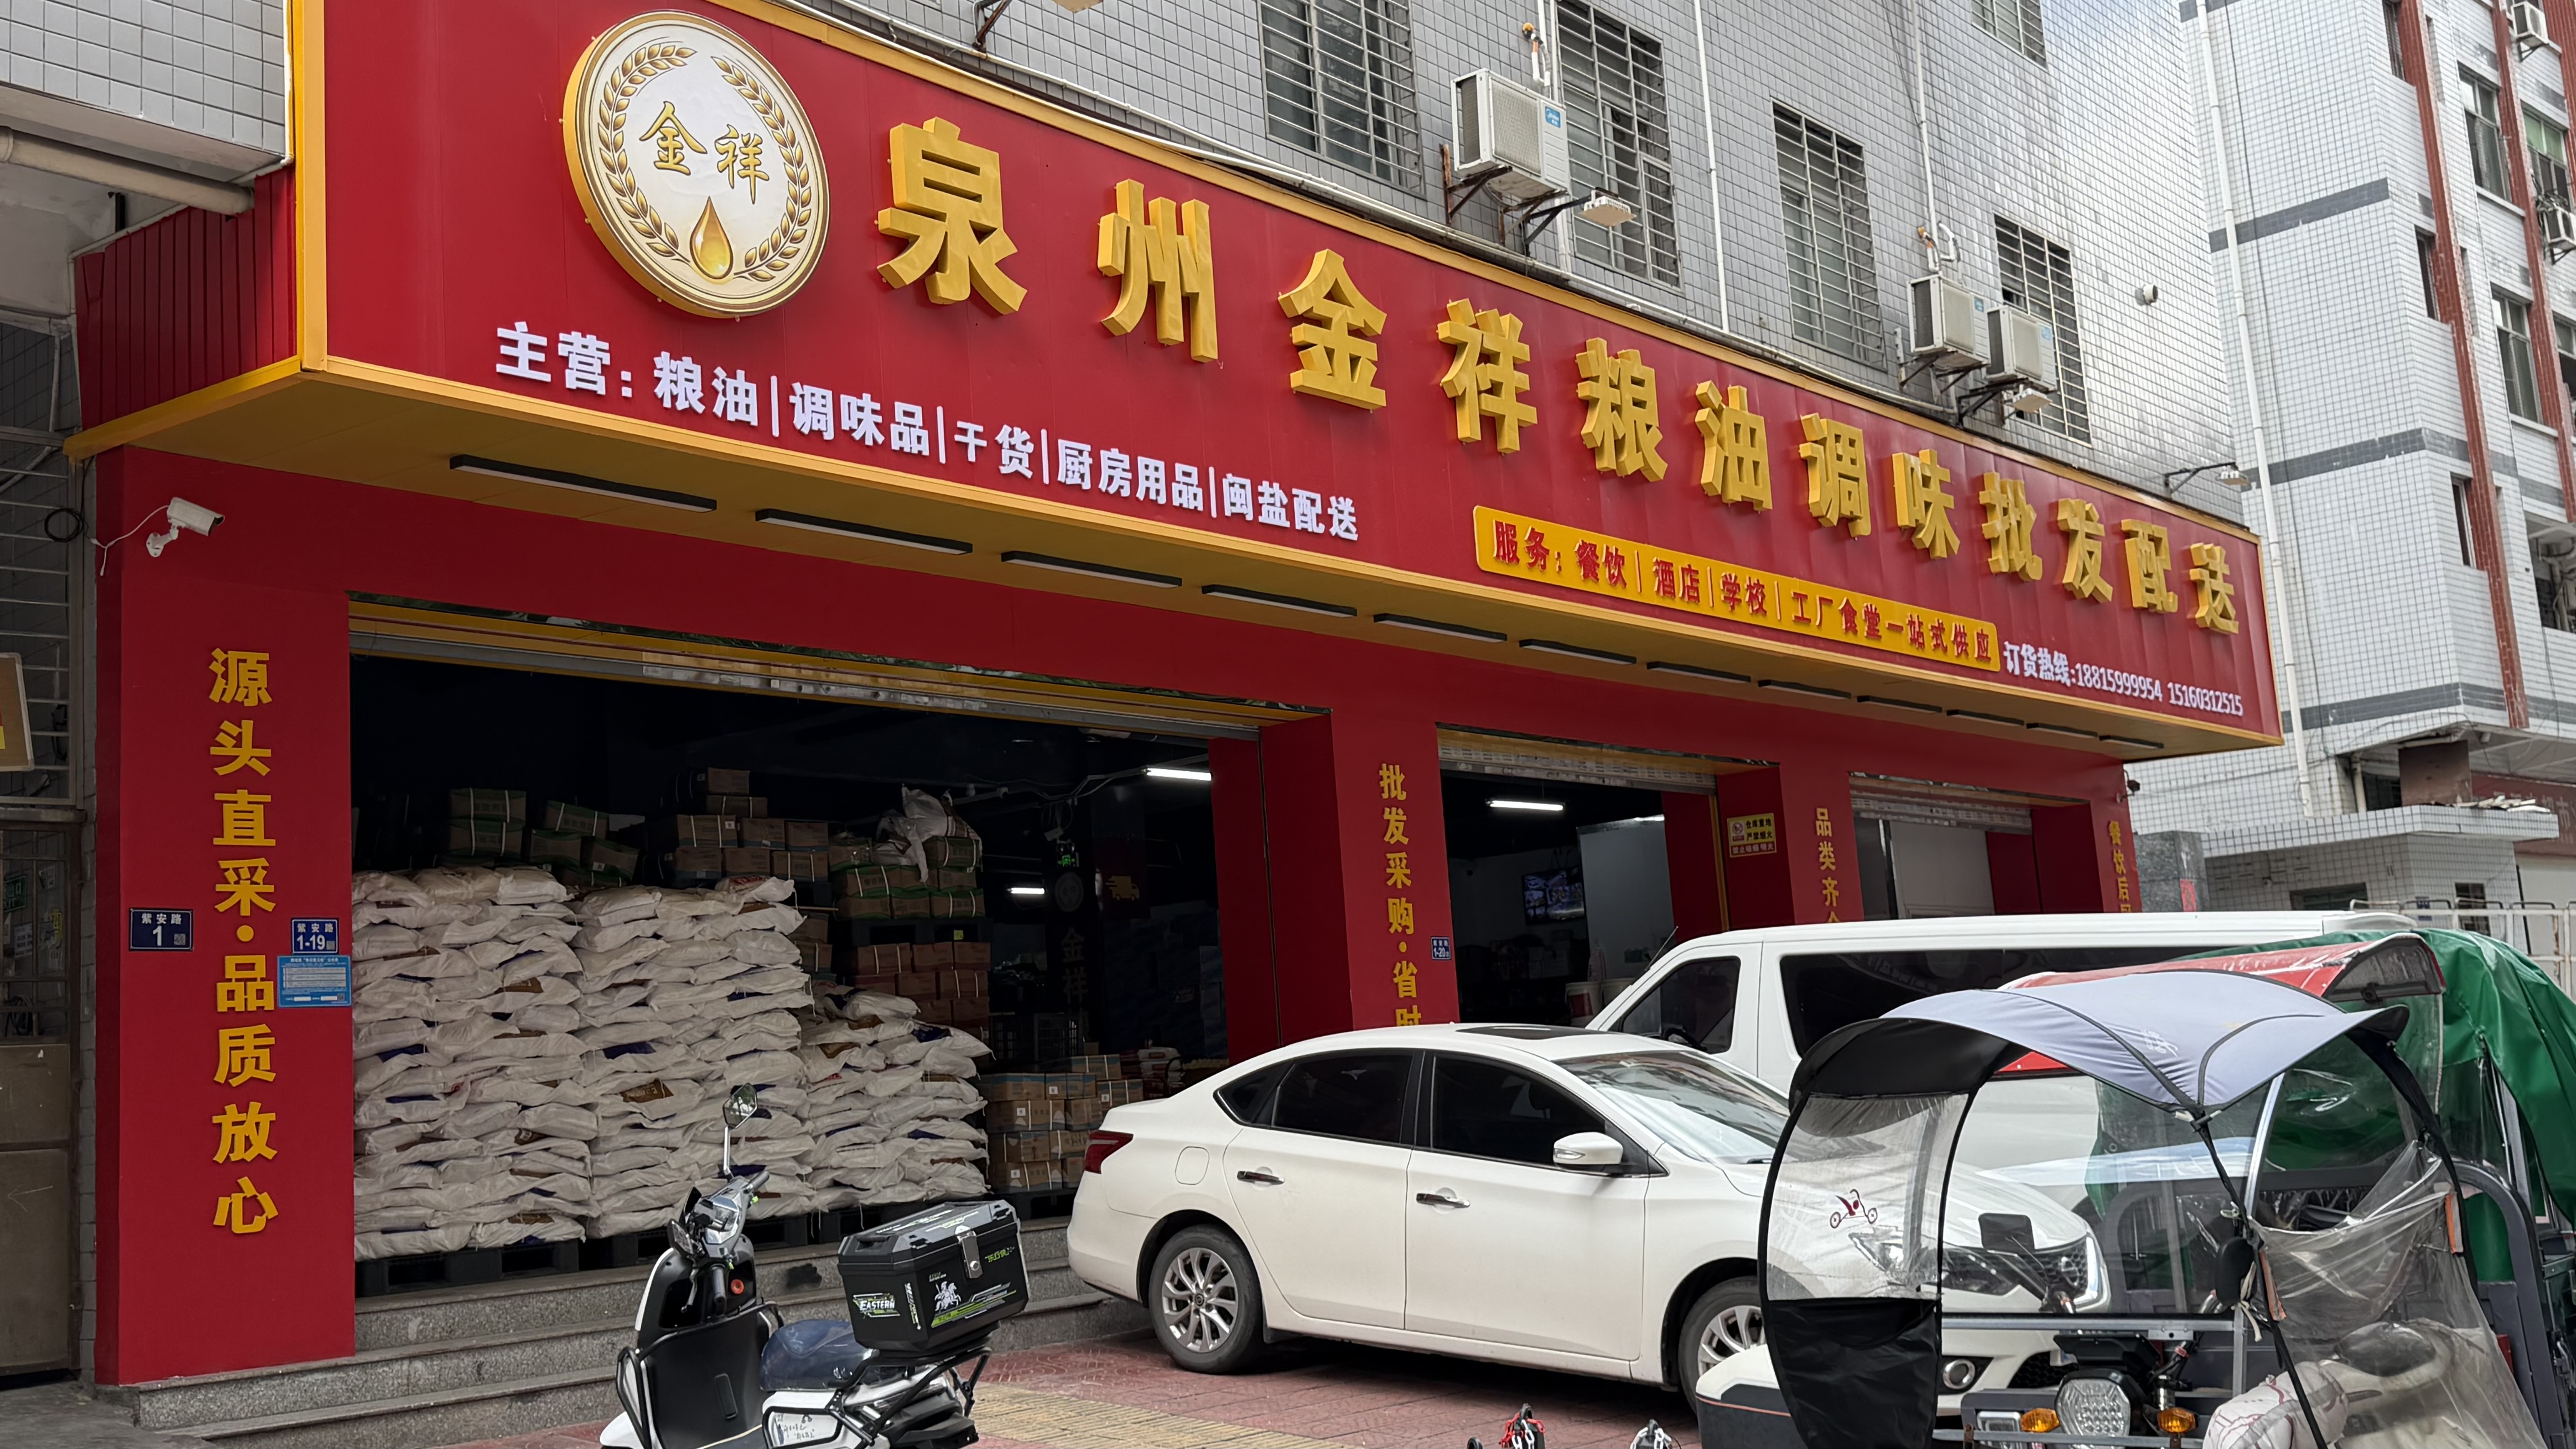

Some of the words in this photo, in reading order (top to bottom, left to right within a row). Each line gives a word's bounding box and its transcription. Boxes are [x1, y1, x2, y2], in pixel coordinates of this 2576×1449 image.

[639, 100, 770, 204] 金祥
[877, 116, 2239, 635] 泉州金祥粮油调味批发配送
[2167, 681, 2244, 716] 15160312515
[142, 912, 182, 925] 紫安路
[297, 923, 334, 933] 紫安路
[152, 925, 162, 946] 1
[297, 934, 325, 950] 1-19
